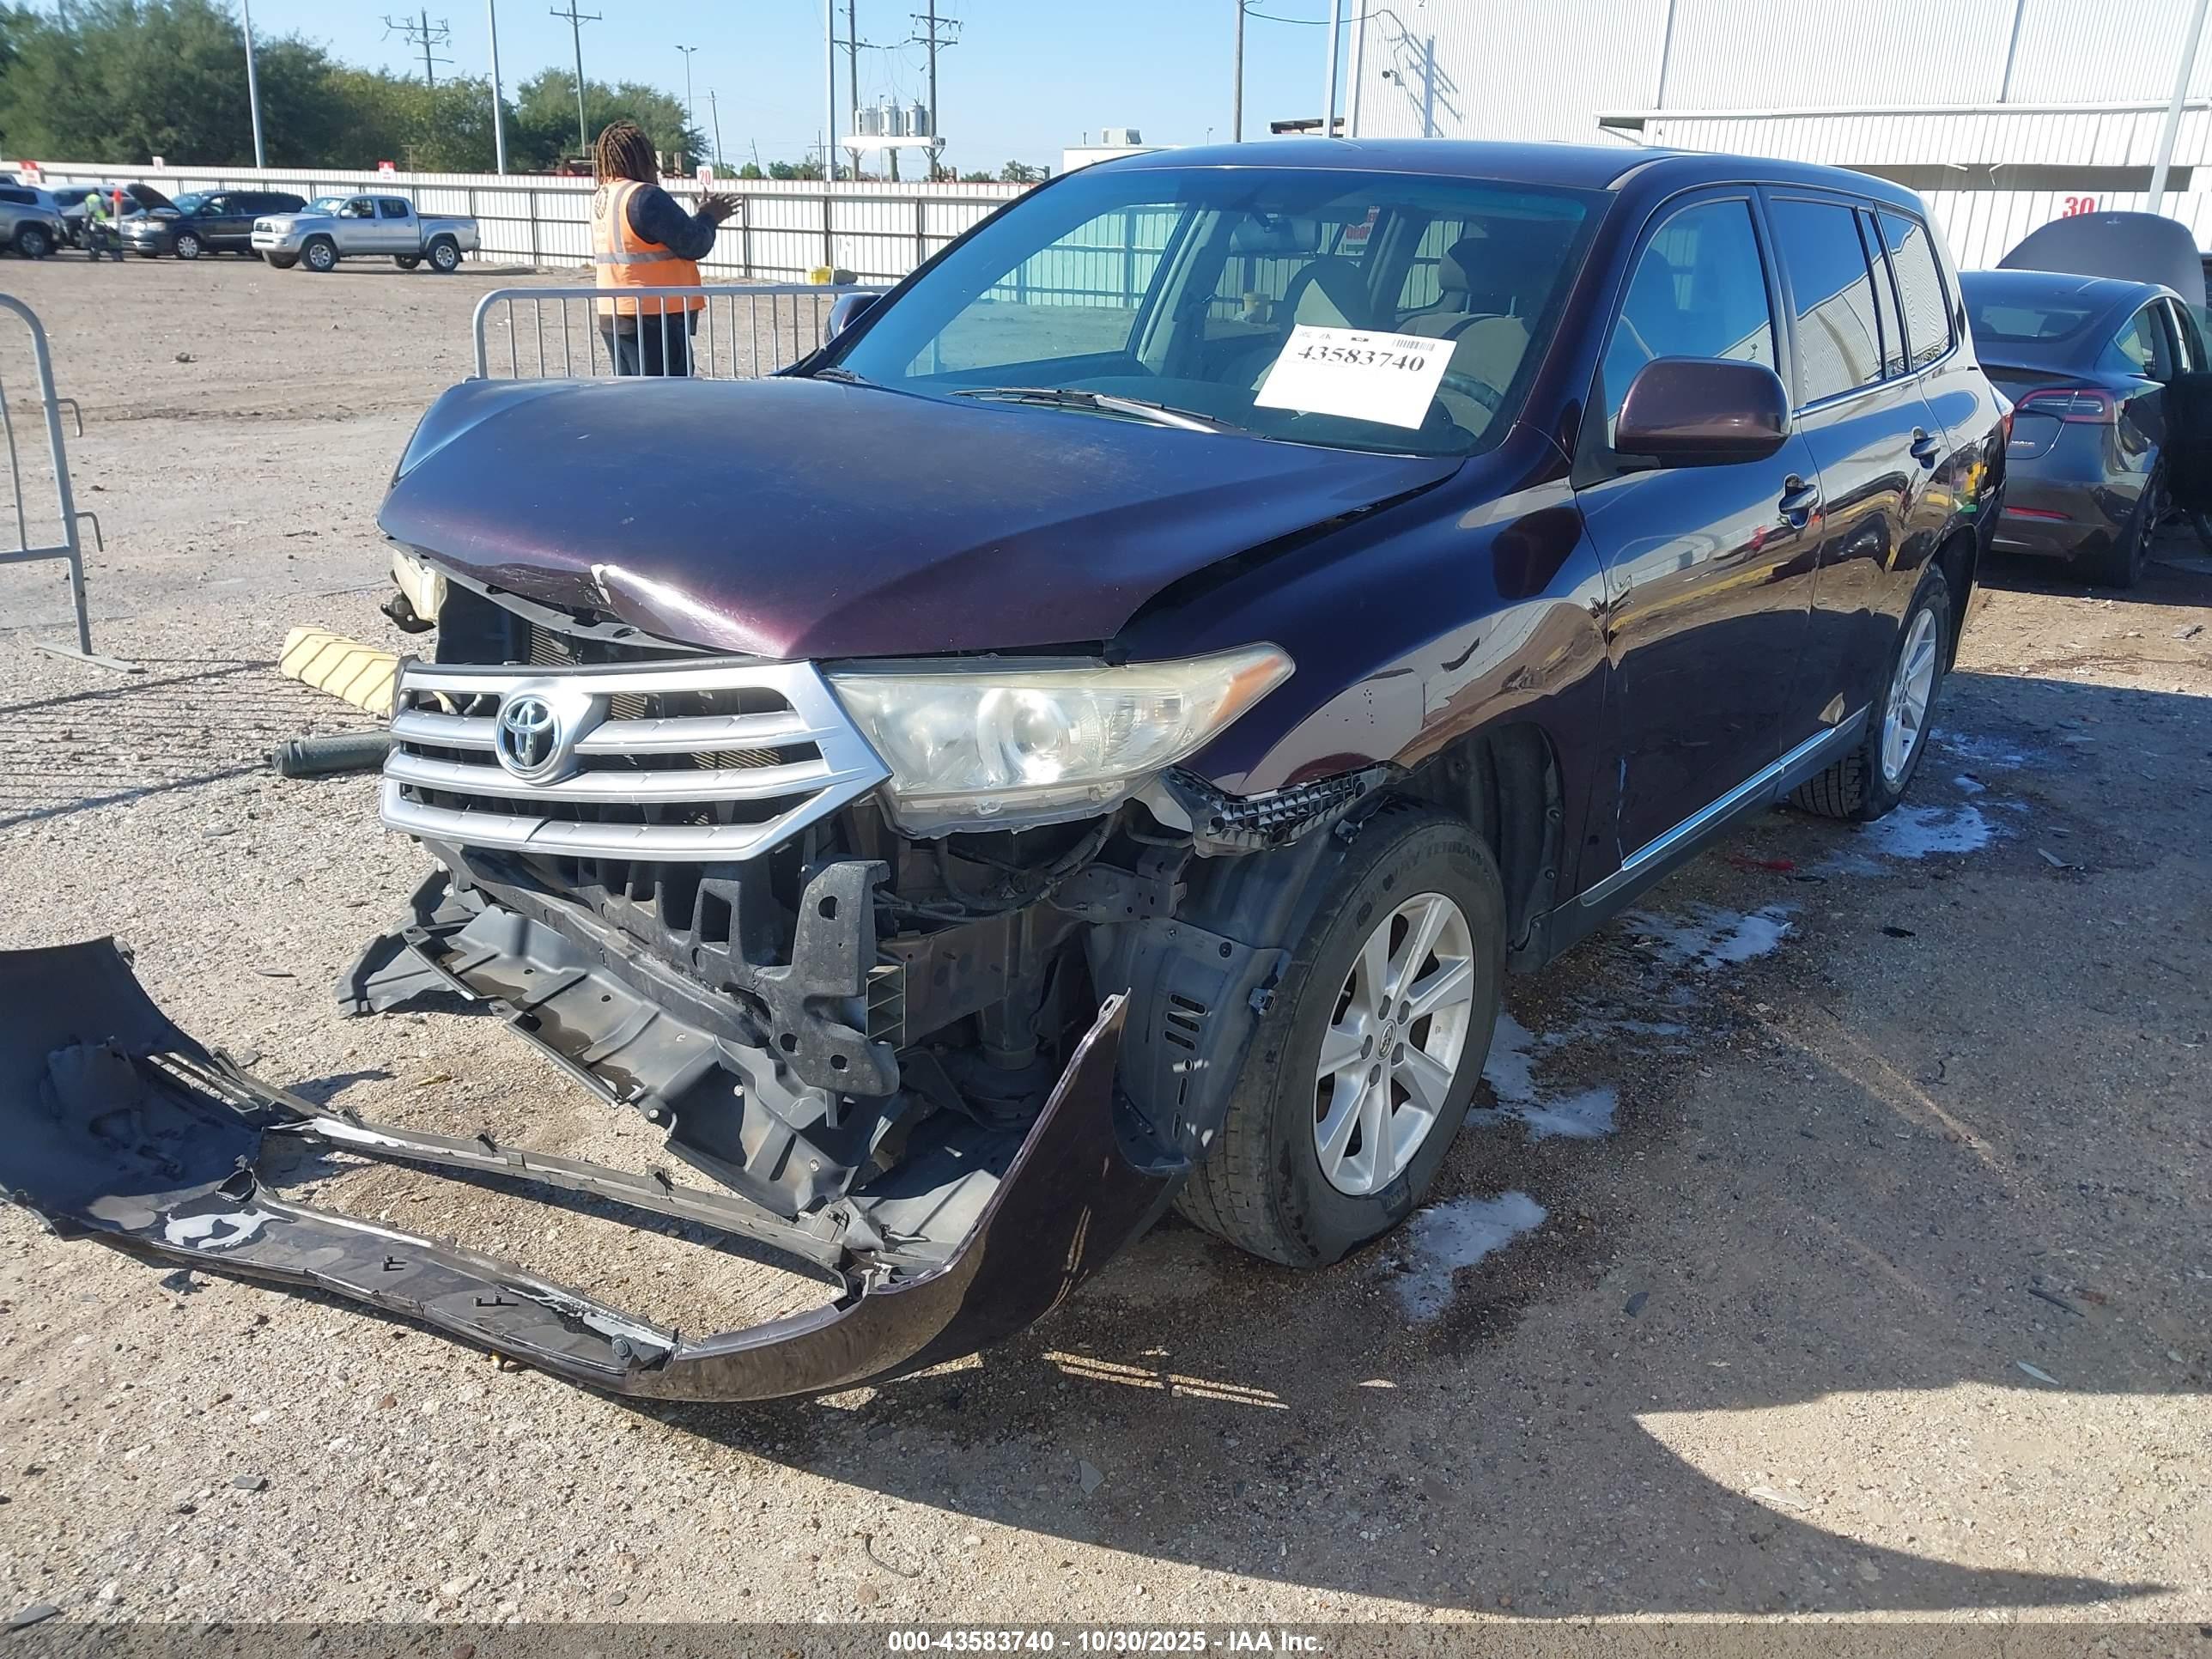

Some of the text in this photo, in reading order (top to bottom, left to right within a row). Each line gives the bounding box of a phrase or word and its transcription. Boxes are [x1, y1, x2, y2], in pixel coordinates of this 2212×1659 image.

[699, 169, 711, 185] 20
[2063, 197, 2095, 218] 30
[1297, 345, 1425, 372] 43583740
